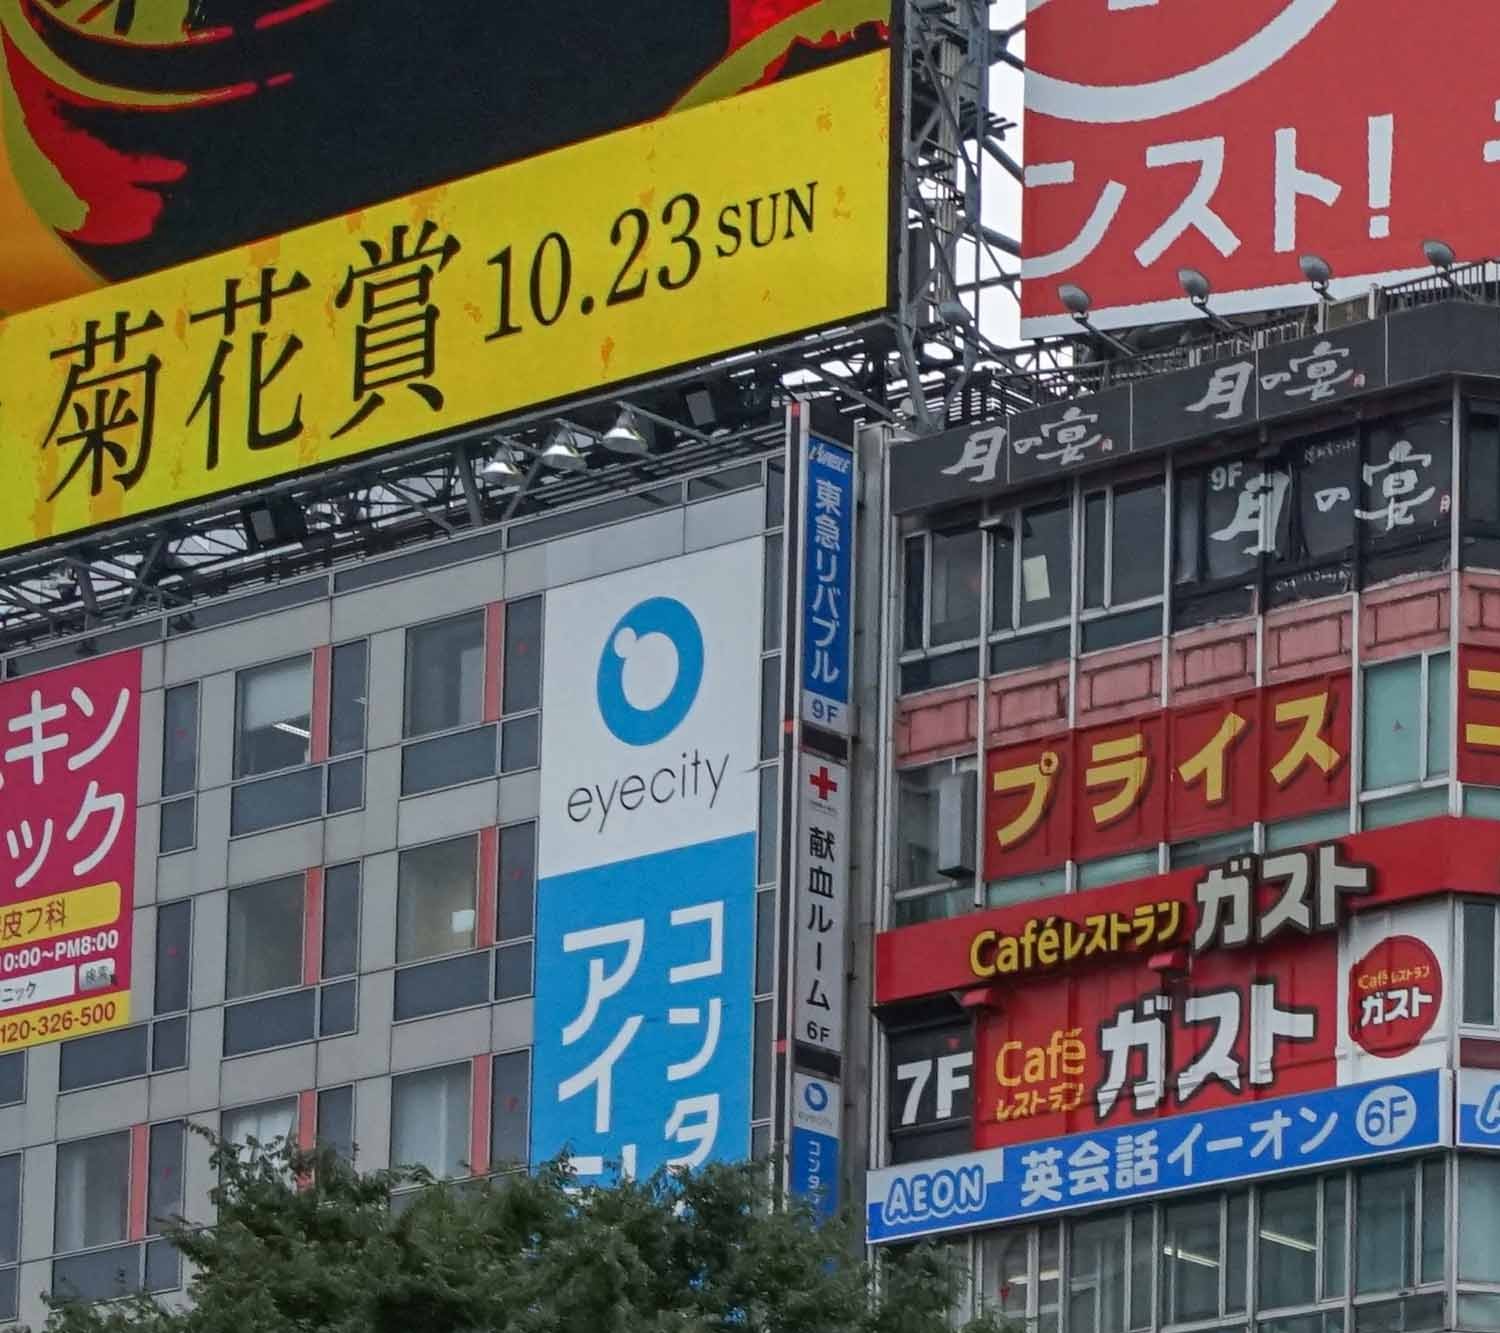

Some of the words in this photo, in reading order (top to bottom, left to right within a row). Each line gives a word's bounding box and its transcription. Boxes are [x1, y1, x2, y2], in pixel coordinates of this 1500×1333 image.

[43, 220, 461, 502] 菊花賞
[484, 193, 702, 344] 10.23
[716, 181, 818, 257] SUN
[1187, 341, 1353, 419] 月の宴
[941, 405, 1102, 482] 月の宴
[1210, 463, 1243, 492] 9F
[1209, 439, 1435, 557] 月の宴
[810, 478, 843, 684] 東急リバブル
[811, 702, 838, 724] 9F
[567, 754, 729, 833] eyecity
[993, 691, 1340, 846] プライス
[806, 824, 837, 1013] 献血ルーム
[1194, 846, 1370, 951] ガスト
[806, 1021, 831, 1042] 6F
[1360, 987, 1433, 1026] ガスト
[897, 1051, 973, 1124] 7F
[996, 1028, 1087, 1087] Café
[1097, 982, 1315, 1118] ガスト
[996, 1084, 1084, 1122] レストラン
[885, 1166, 986, 1225] AEON
[1020, 1108, 1339, 1207] 英会話イーオン
[1364, 1091, 1410, 1138] 6F
